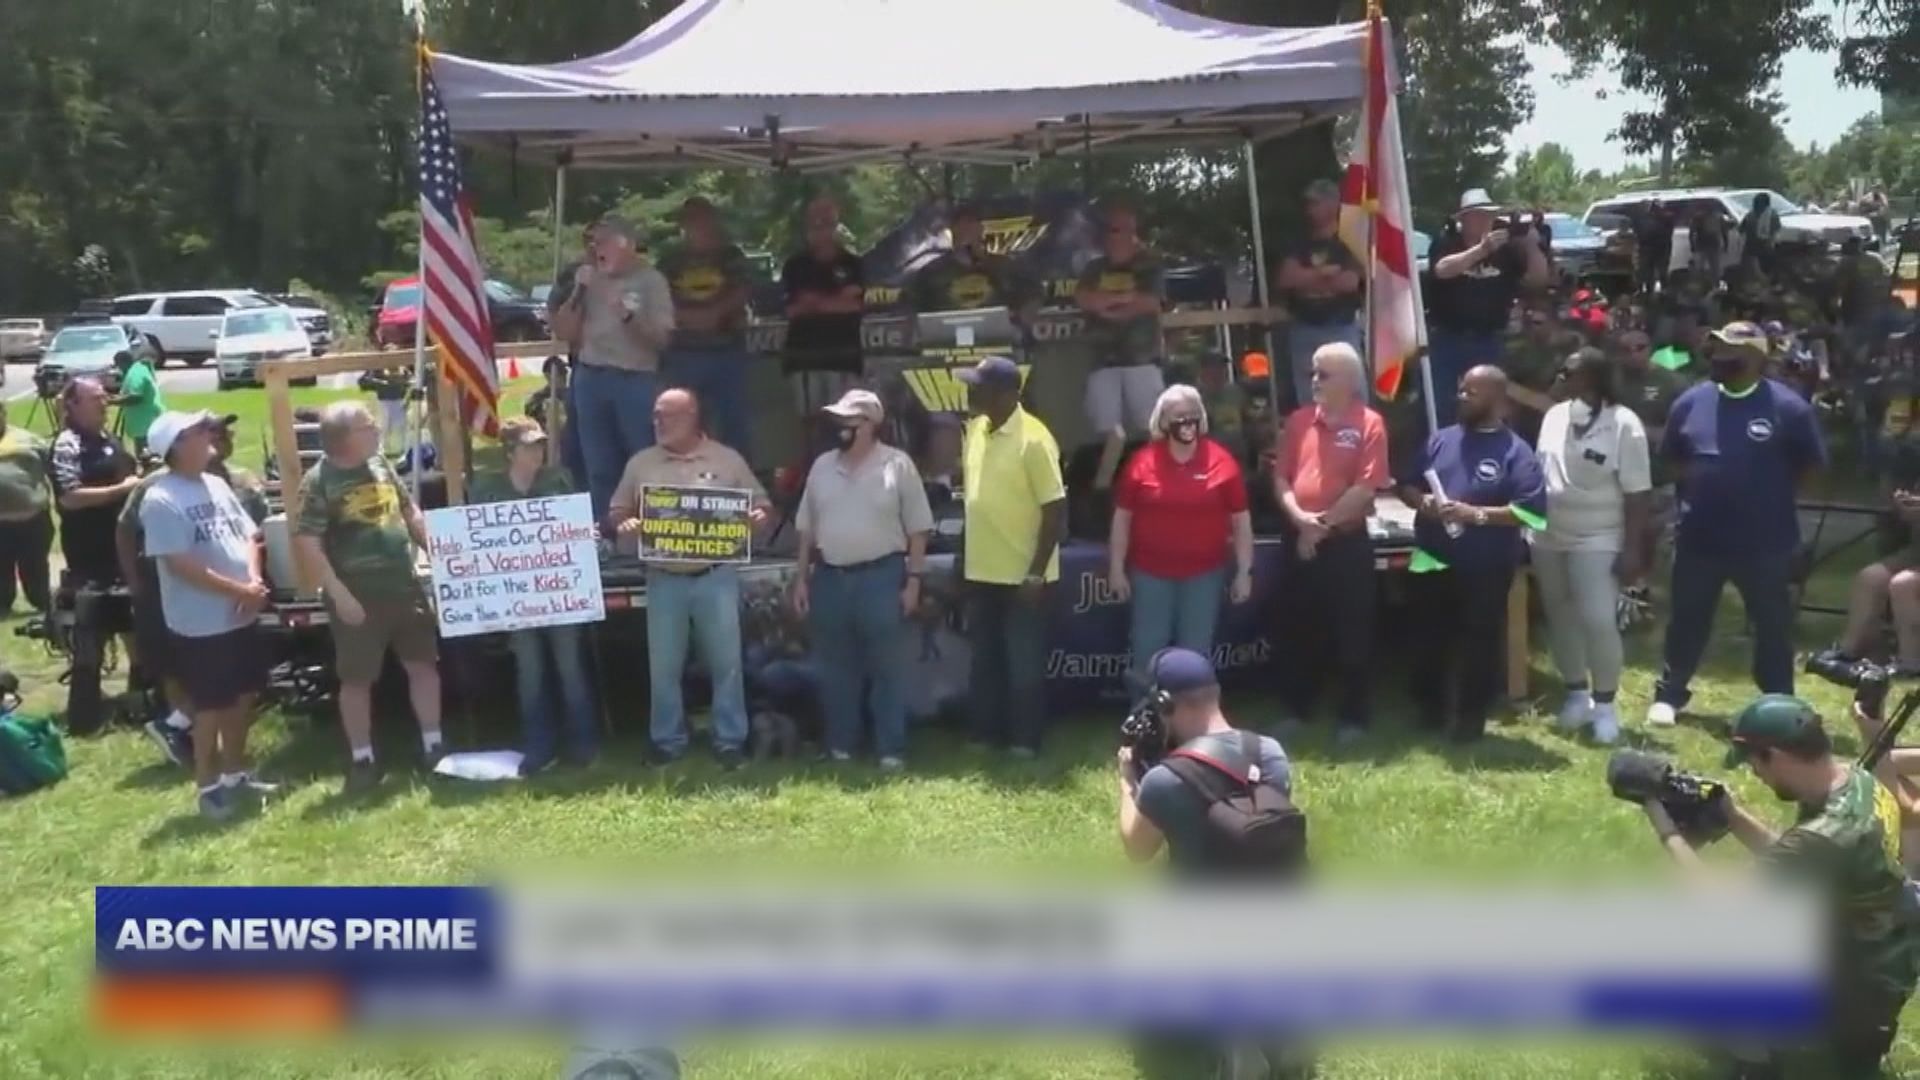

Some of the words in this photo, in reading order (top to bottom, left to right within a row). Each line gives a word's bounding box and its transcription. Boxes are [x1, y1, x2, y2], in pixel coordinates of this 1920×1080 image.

[681, 496, 699, 509] ON
[701, 497, 748, 510] STRIKE
[466, 500, 557, 530] PLEASE
[470, 531, 508, 550] Save
[509, 528, 537, 546] Our
[643, 520, 695, 536] UNFAIR
[699, 522, 747, 538] LABOR
[655, 538, 735, 555] PRACTICES
[446, 554, 480, 578] Get
[486, 544, 572, 572] Vacinated
[440, 584, 460, 602] Do
[463, 581, 474, 599] it
[477, 580, 497, 596] for
[504, 577, 529, 595] the
